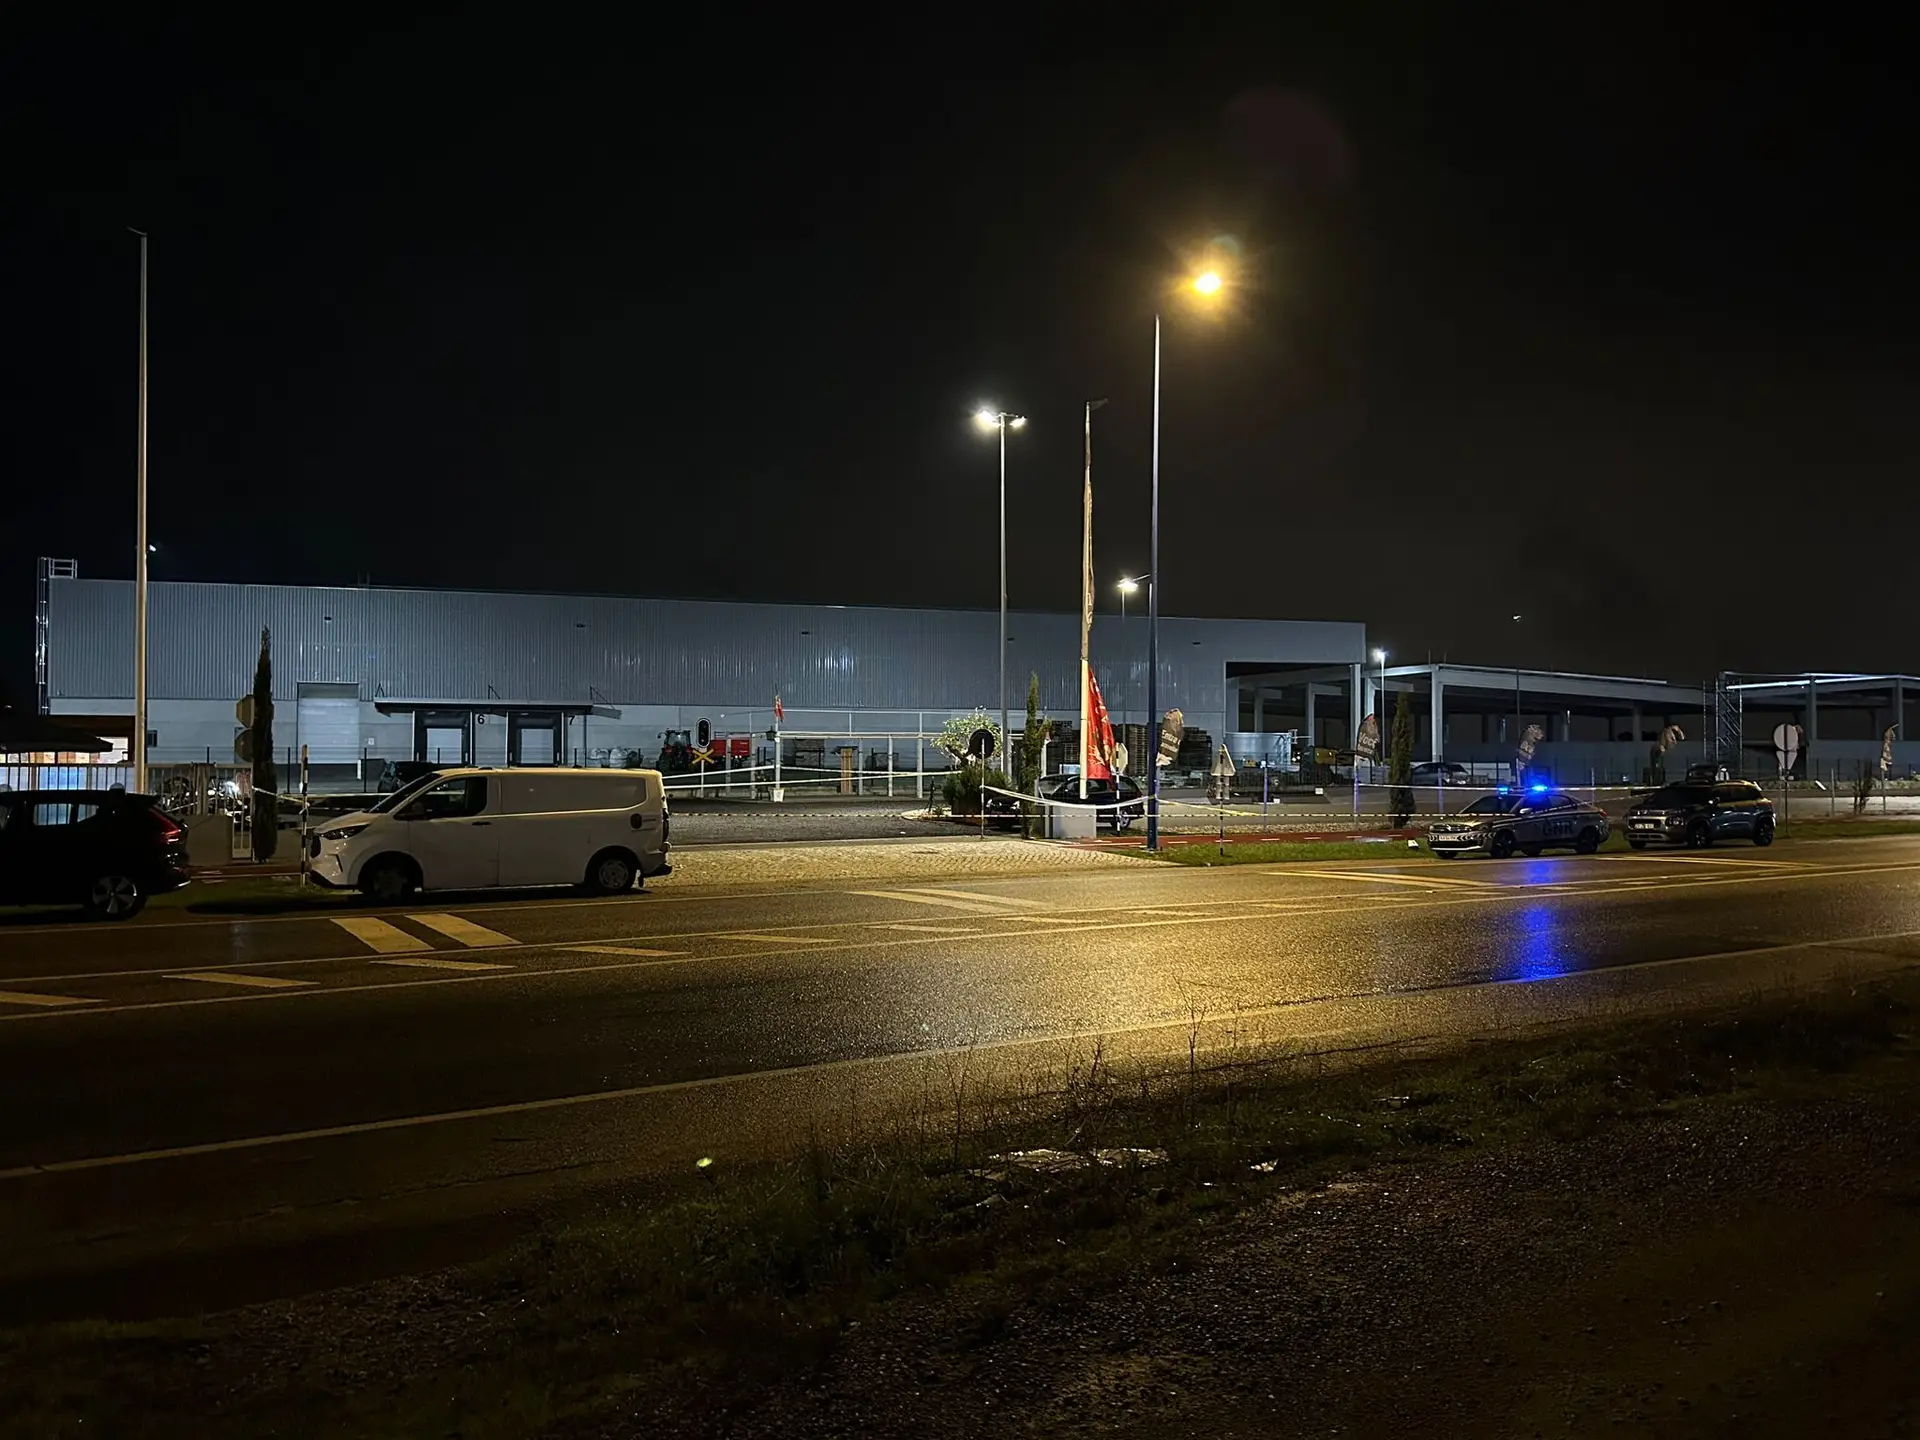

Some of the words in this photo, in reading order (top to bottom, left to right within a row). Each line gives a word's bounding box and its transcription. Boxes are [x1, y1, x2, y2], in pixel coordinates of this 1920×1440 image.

[477, 713, 486, 725] 6
[568, 714, 576, 726] 7
[1543, 820, 1573, 836] GNR
